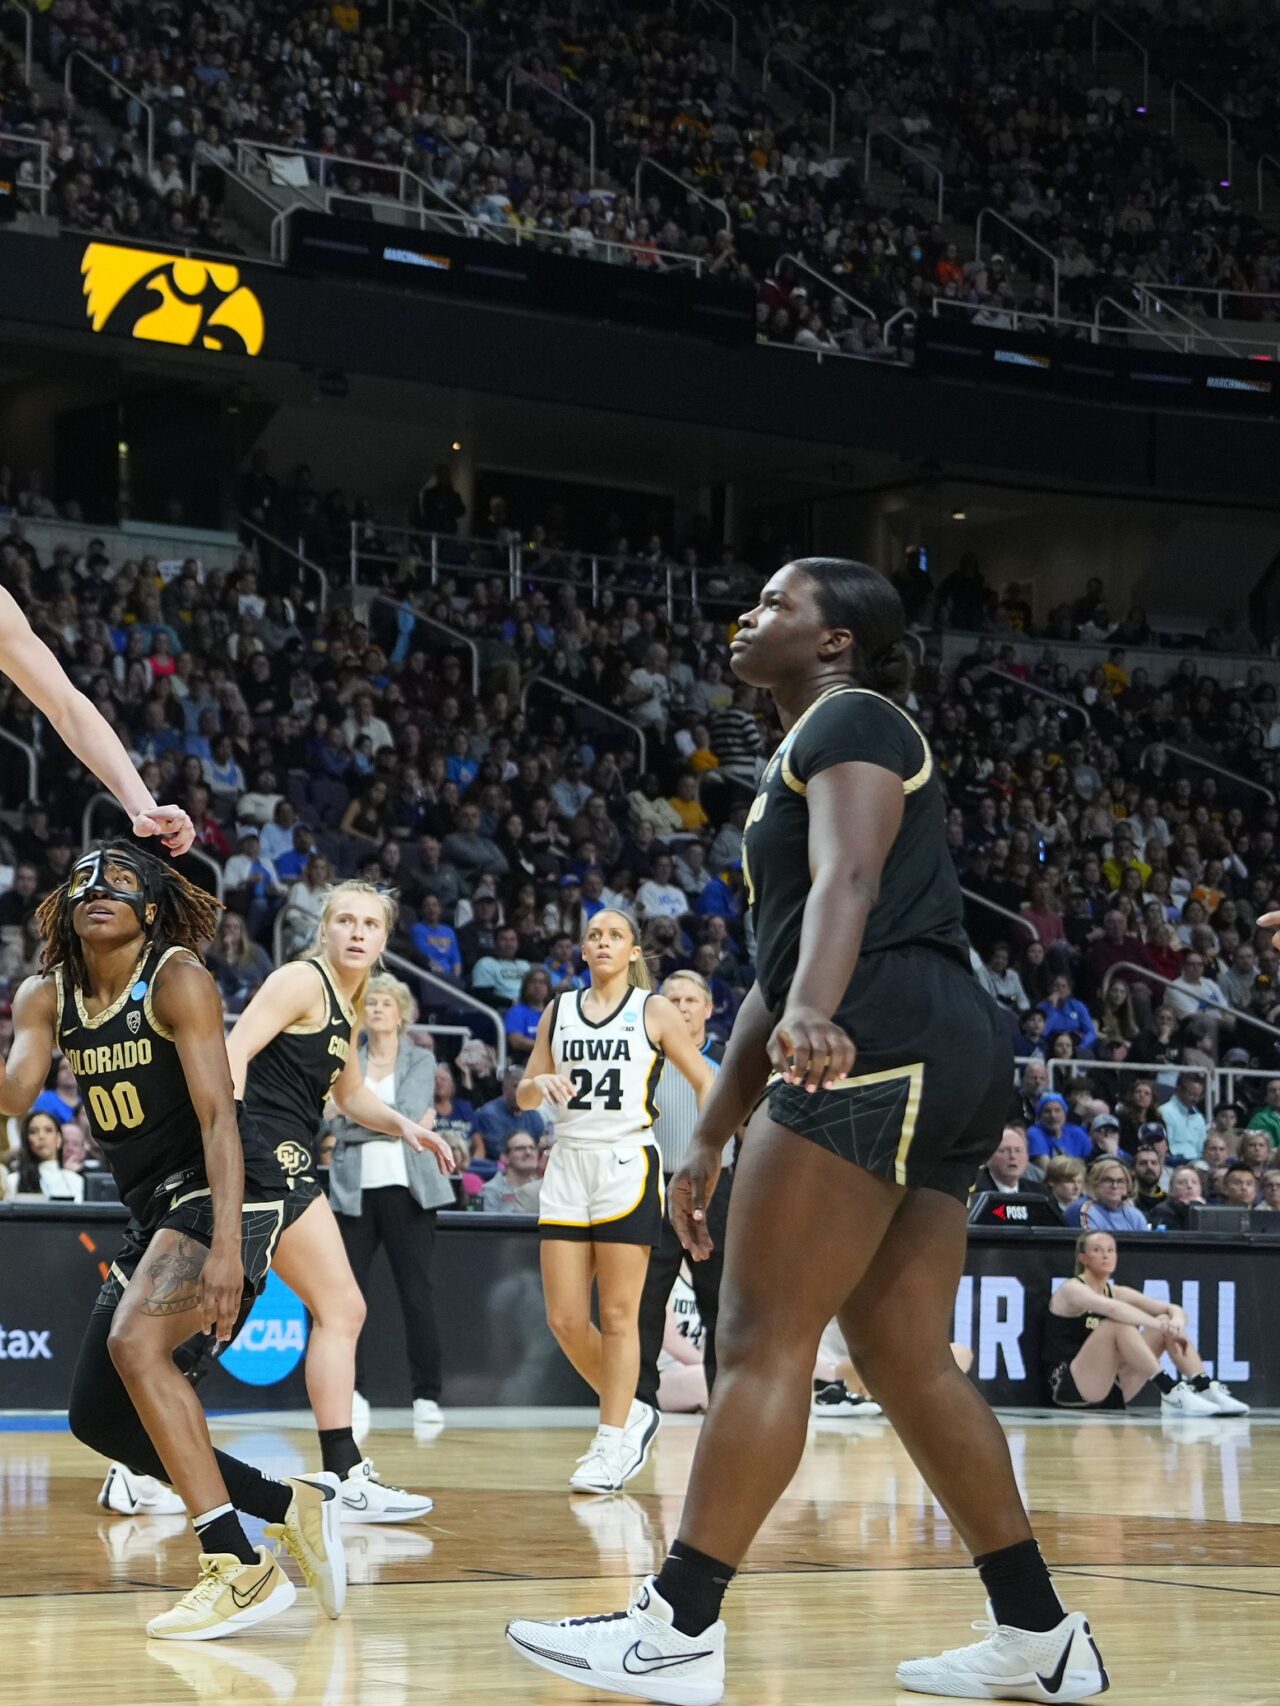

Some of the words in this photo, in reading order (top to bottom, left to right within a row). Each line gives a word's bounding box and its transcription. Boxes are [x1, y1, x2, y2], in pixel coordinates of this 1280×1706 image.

[562, 1038, 632, 1062] IOWA
[88, 1080, 145, 1132] 00
[567, 1068, 624, 1111] 24
[1006, 1205, 1028, 1220] POSS
